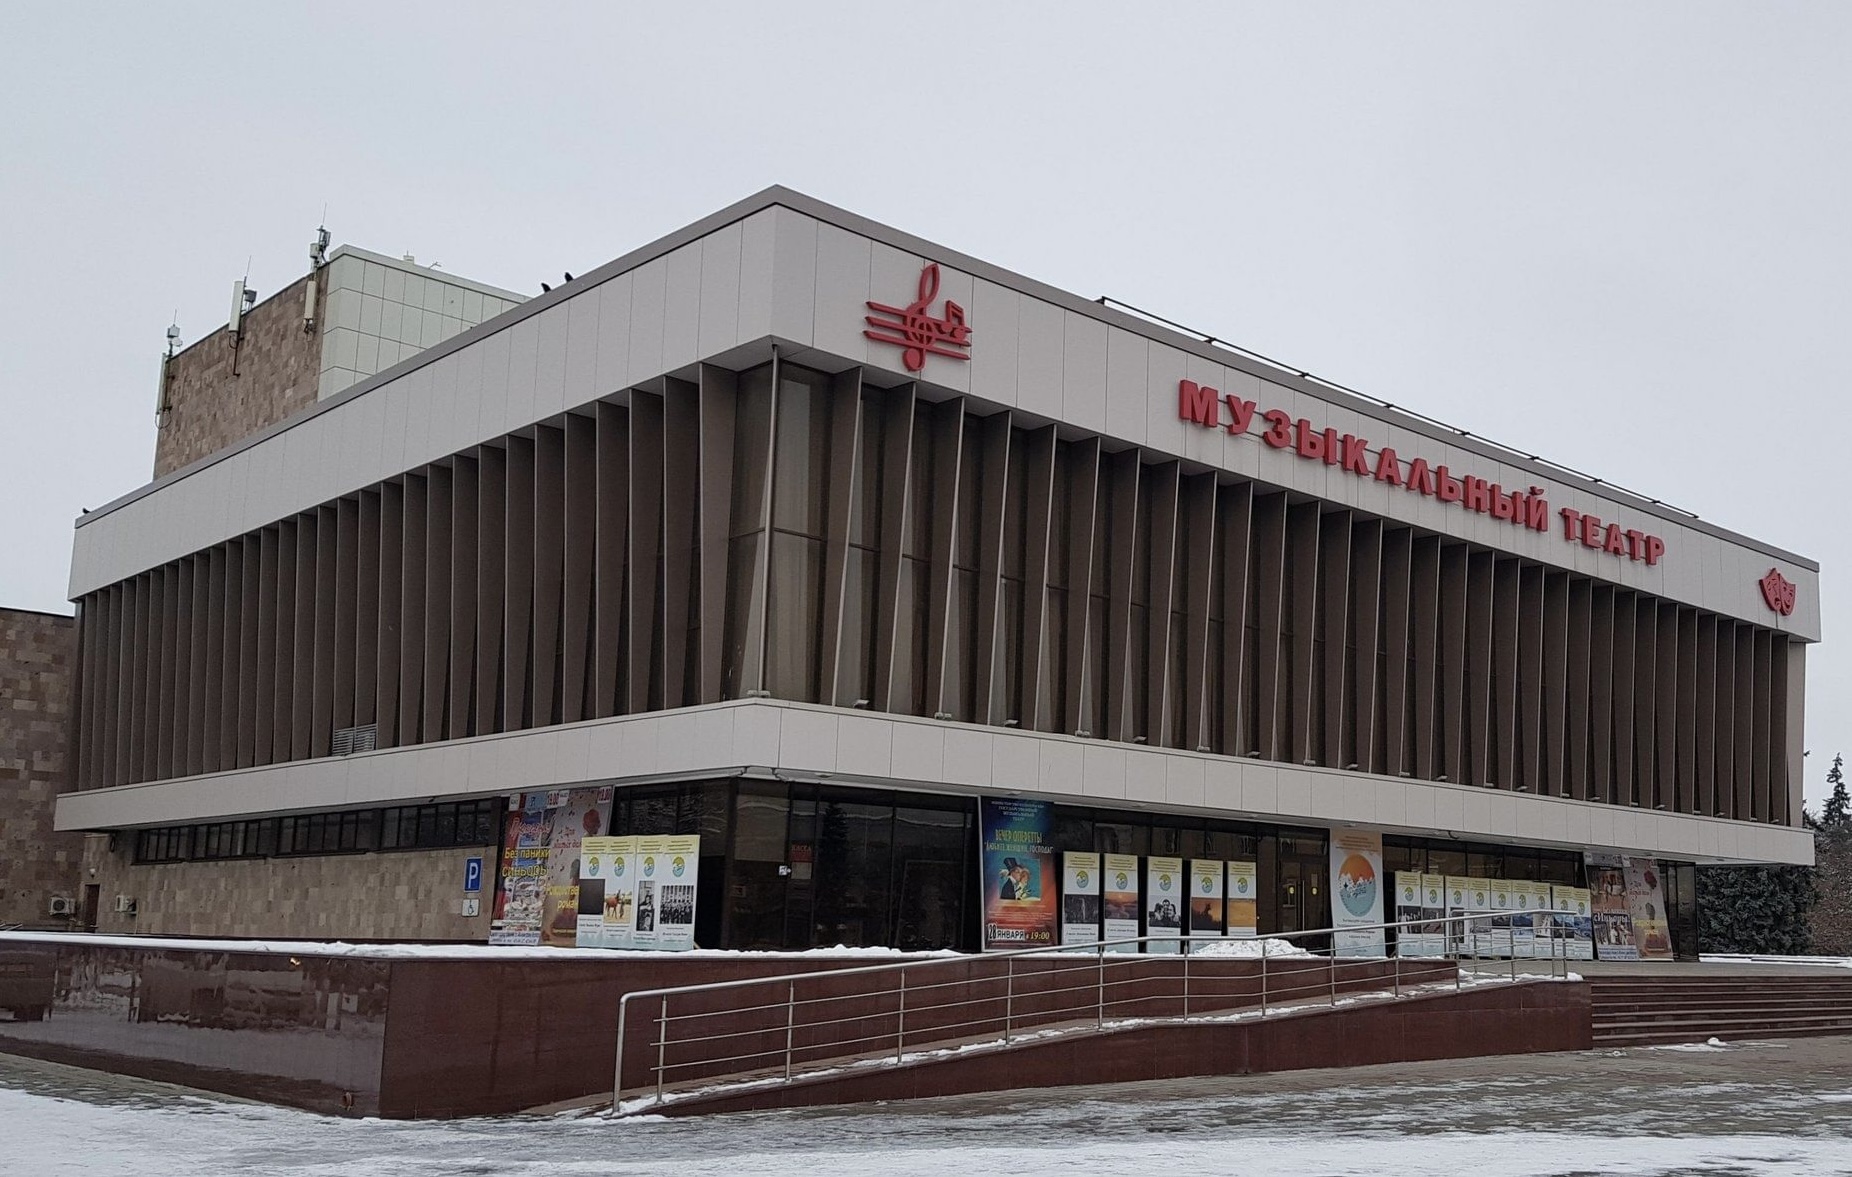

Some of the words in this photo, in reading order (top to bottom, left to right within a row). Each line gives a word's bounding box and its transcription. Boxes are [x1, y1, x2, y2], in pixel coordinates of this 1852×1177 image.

[1179, 379, 1549, 532] МУЗЫКАЛЬНЫЙ
[1561, 507, 1665, 566] ТЕАТР
[995, 829, 1012, 841] ВЕЧЕР
[1012, 830, 1043, 843] ОПЕРЕТТЫ
[504, 848, 519, 859] Без
[468, 862, 479, 888] P
[988, 924, 997, 940] 28
[997, 930, 1024, 940] ЯНВАРЯ
[1030, 931, 1050, 940] 19:00
